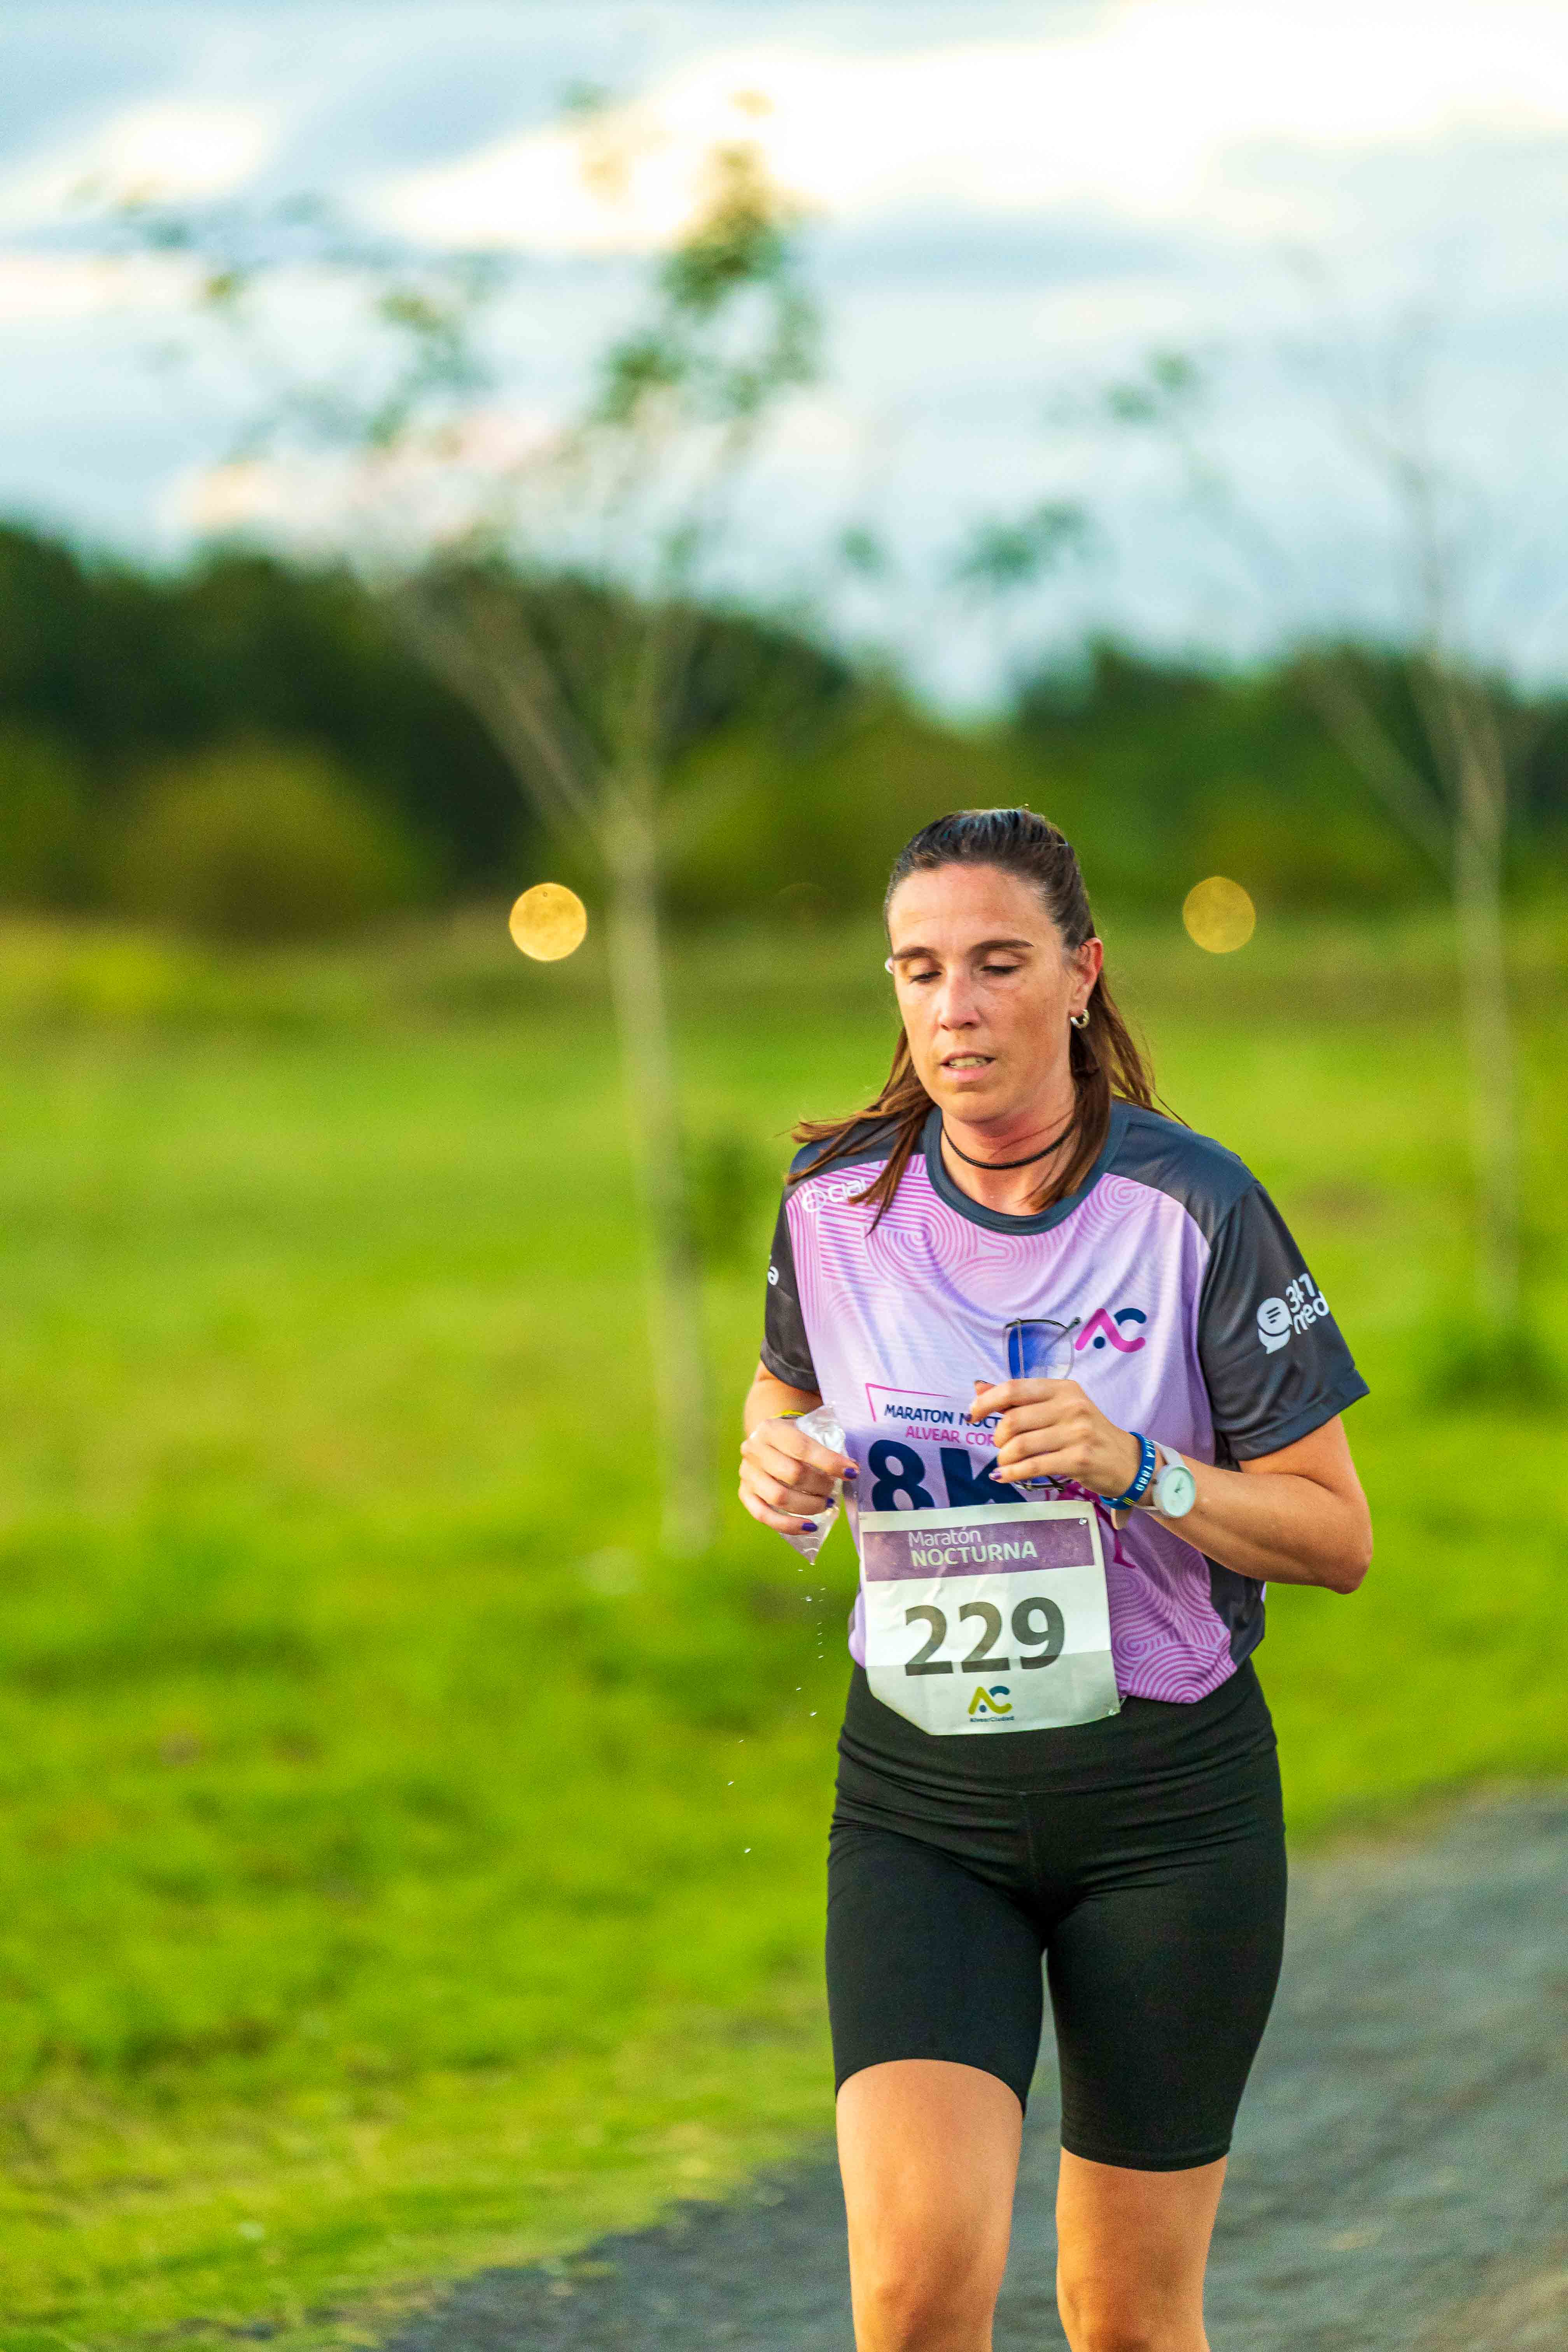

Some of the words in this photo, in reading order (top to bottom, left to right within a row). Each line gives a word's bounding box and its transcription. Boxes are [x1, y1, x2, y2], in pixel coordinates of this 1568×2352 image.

[884, 1404, 954, 1424] MARATON
[905, 1425, 961, 1443] ALVEAR
[908, 1527, 982, 1549] Maratón
[910, 1541, 1038, 1568] NOCTURNA
[905, 1597, 1065, 1676] 229
